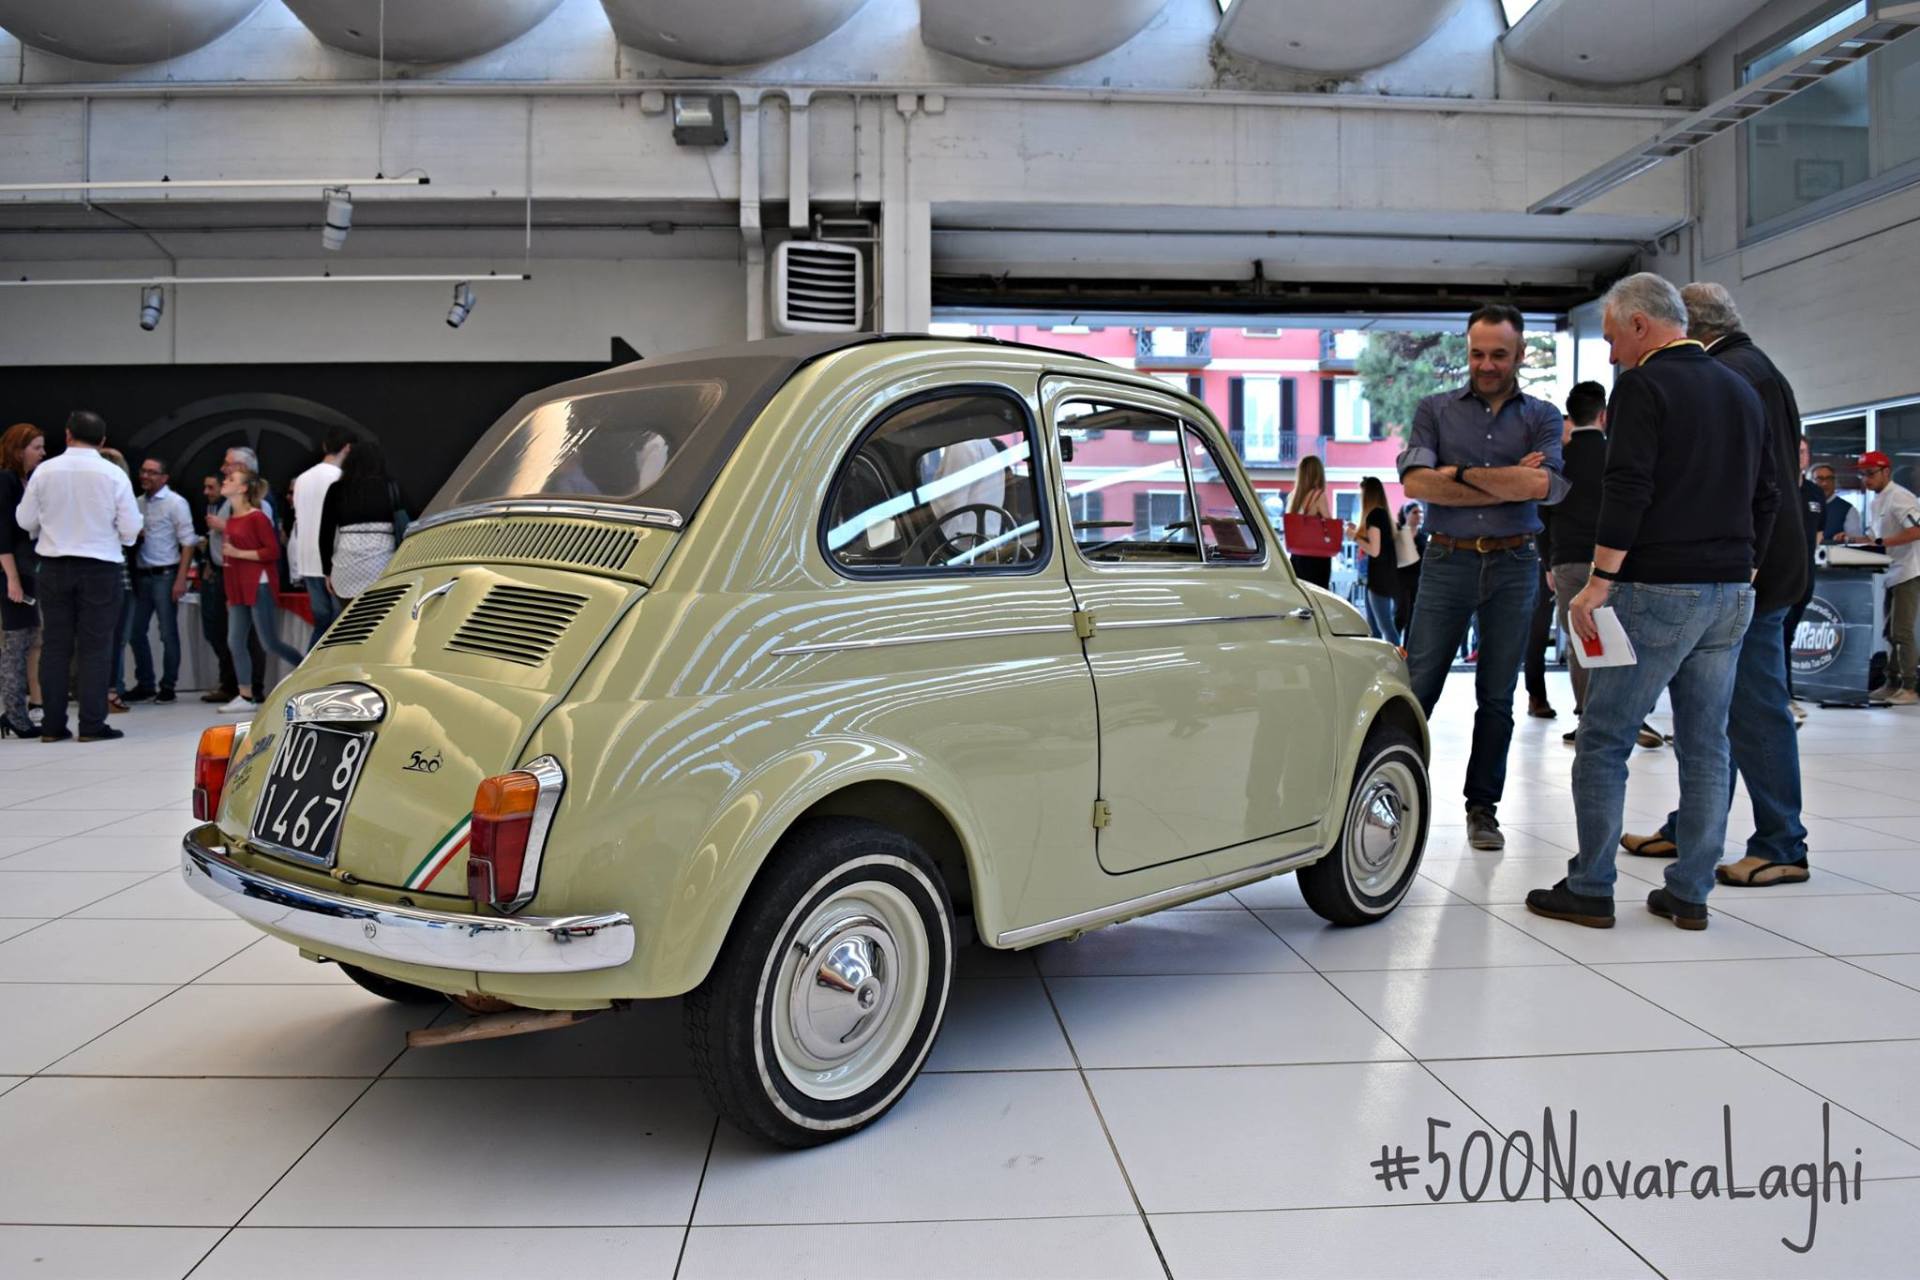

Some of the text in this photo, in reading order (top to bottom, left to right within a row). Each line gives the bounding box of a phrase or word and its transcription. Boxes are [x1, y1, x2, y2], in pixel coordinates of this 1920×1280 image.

[272, 726, 318, 781] NO
[332, 738, 360, 791] 8
[258, 783, 342, 852] 1467
